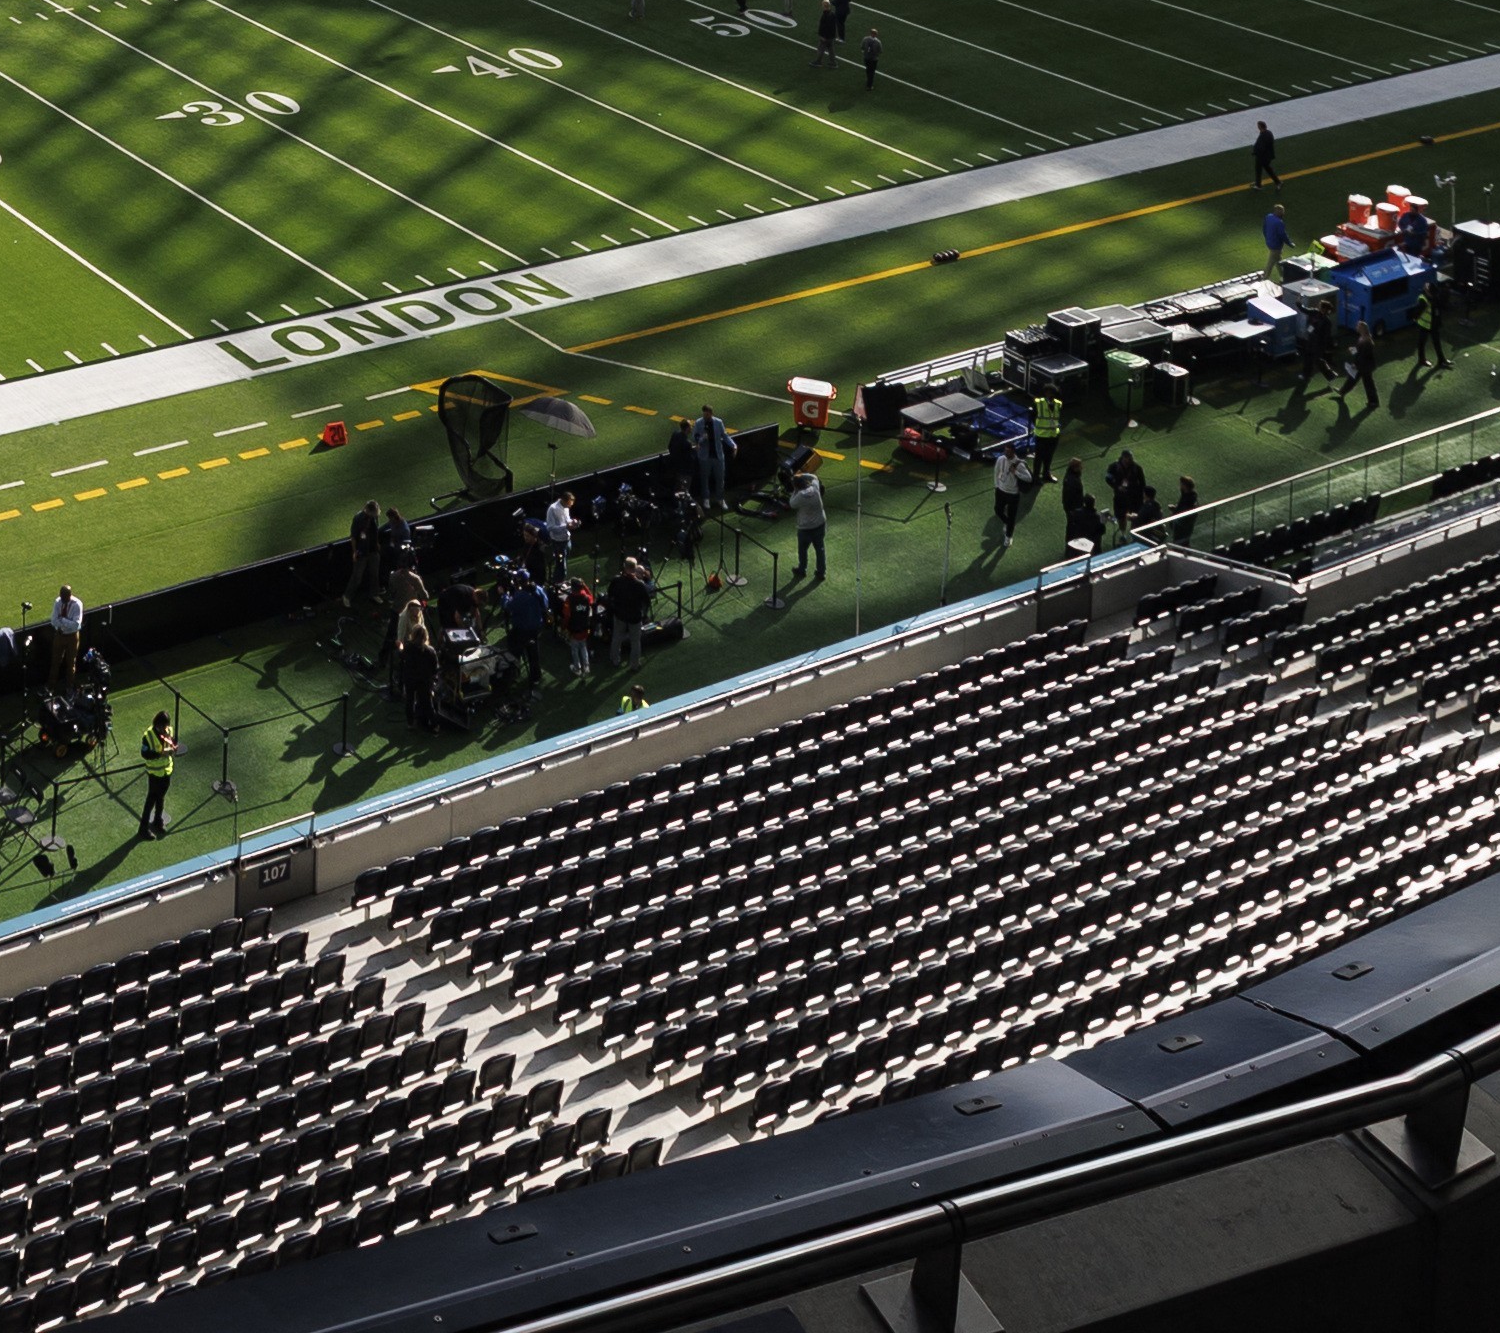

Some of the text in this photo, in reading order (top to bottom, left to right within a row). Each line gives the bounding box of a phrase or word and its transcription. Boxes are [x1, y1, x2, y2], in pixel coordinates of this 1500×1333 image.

[690, 7, 798, 38] 50
[460, 46, 565, 81] 40
[181, 90, 302, 128] 30
[215, 271, 576, 372] LONDON
[800, 399, 821, 420] G
[329, 425, 347, 445] 20
[261, 863, 288, 883] 107
